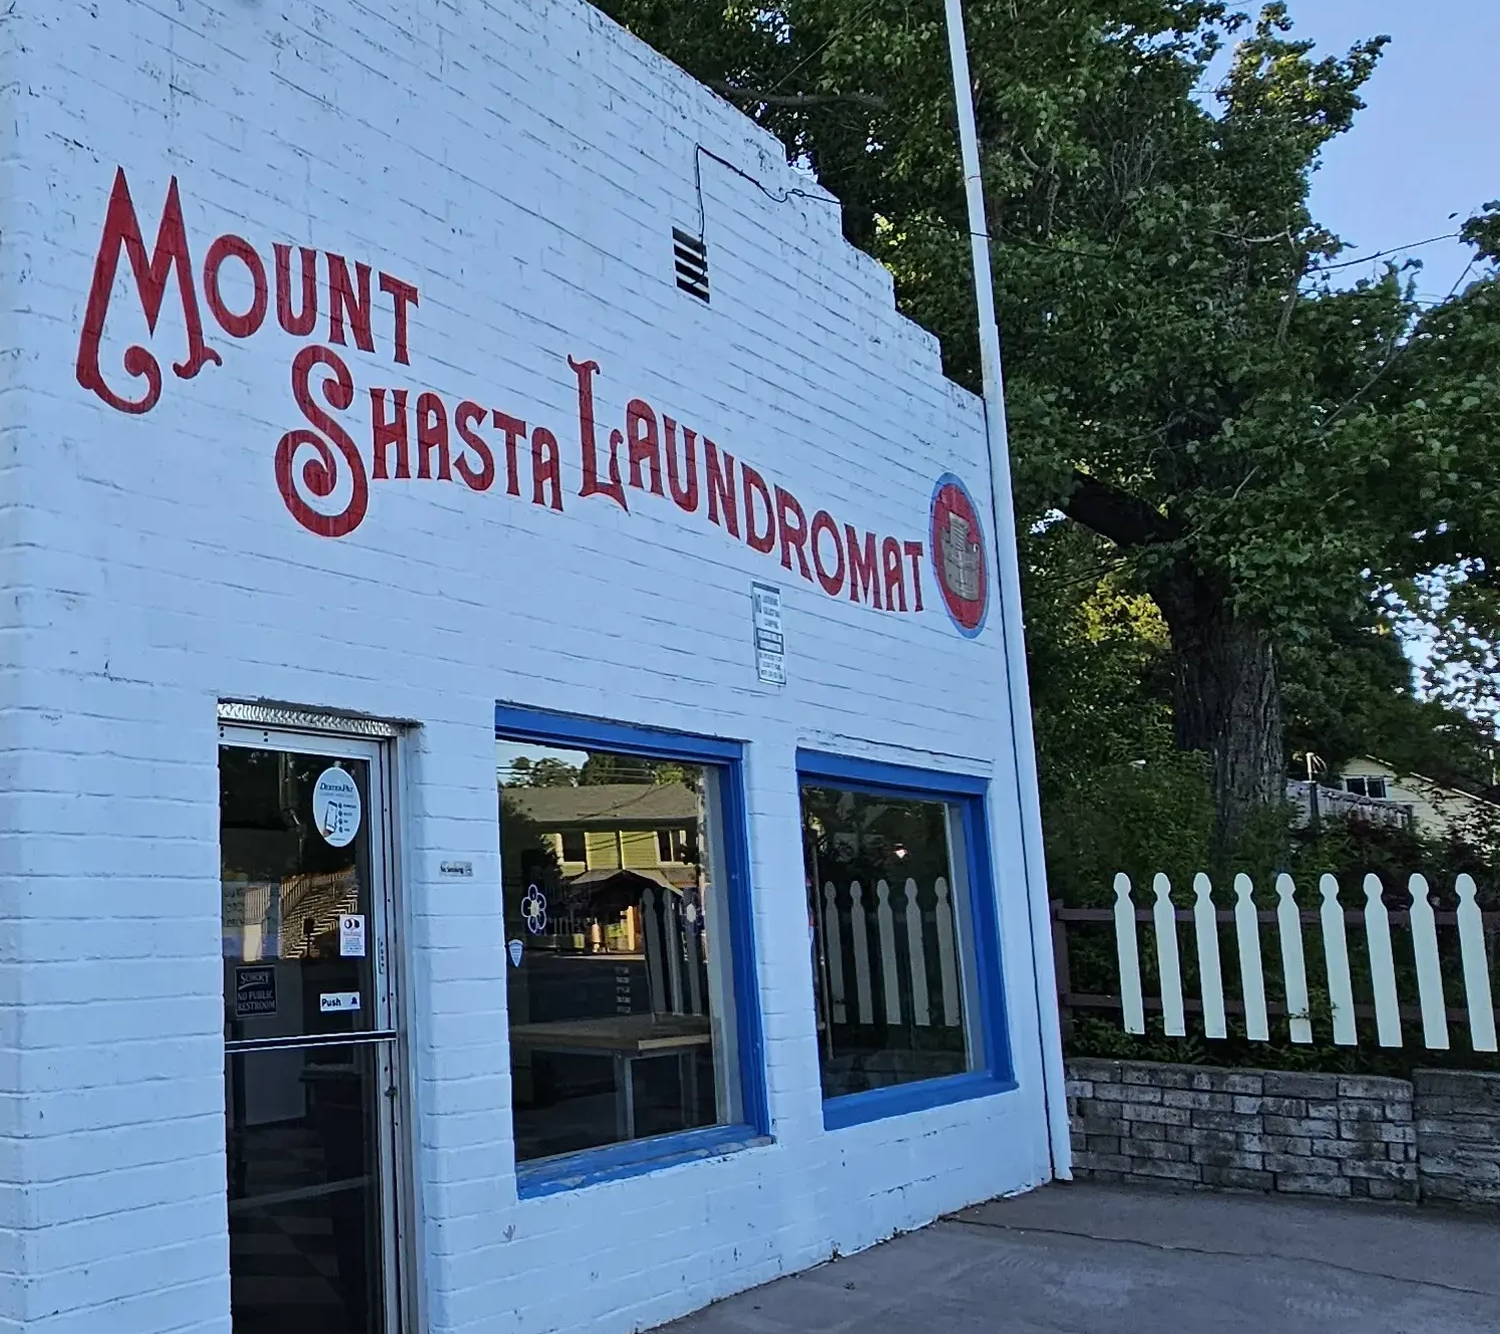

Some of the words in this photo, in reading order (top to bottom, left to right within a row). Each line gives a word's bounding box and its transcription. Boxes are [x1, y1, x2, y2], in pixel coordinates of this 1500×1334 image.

[75, 164, 420, 415] MOUNT
[274, 344, 564, 538] SHASTA
[566, 353, 925, 614] LAUNDROMAT
[321, 997, 342, 1007] Push
